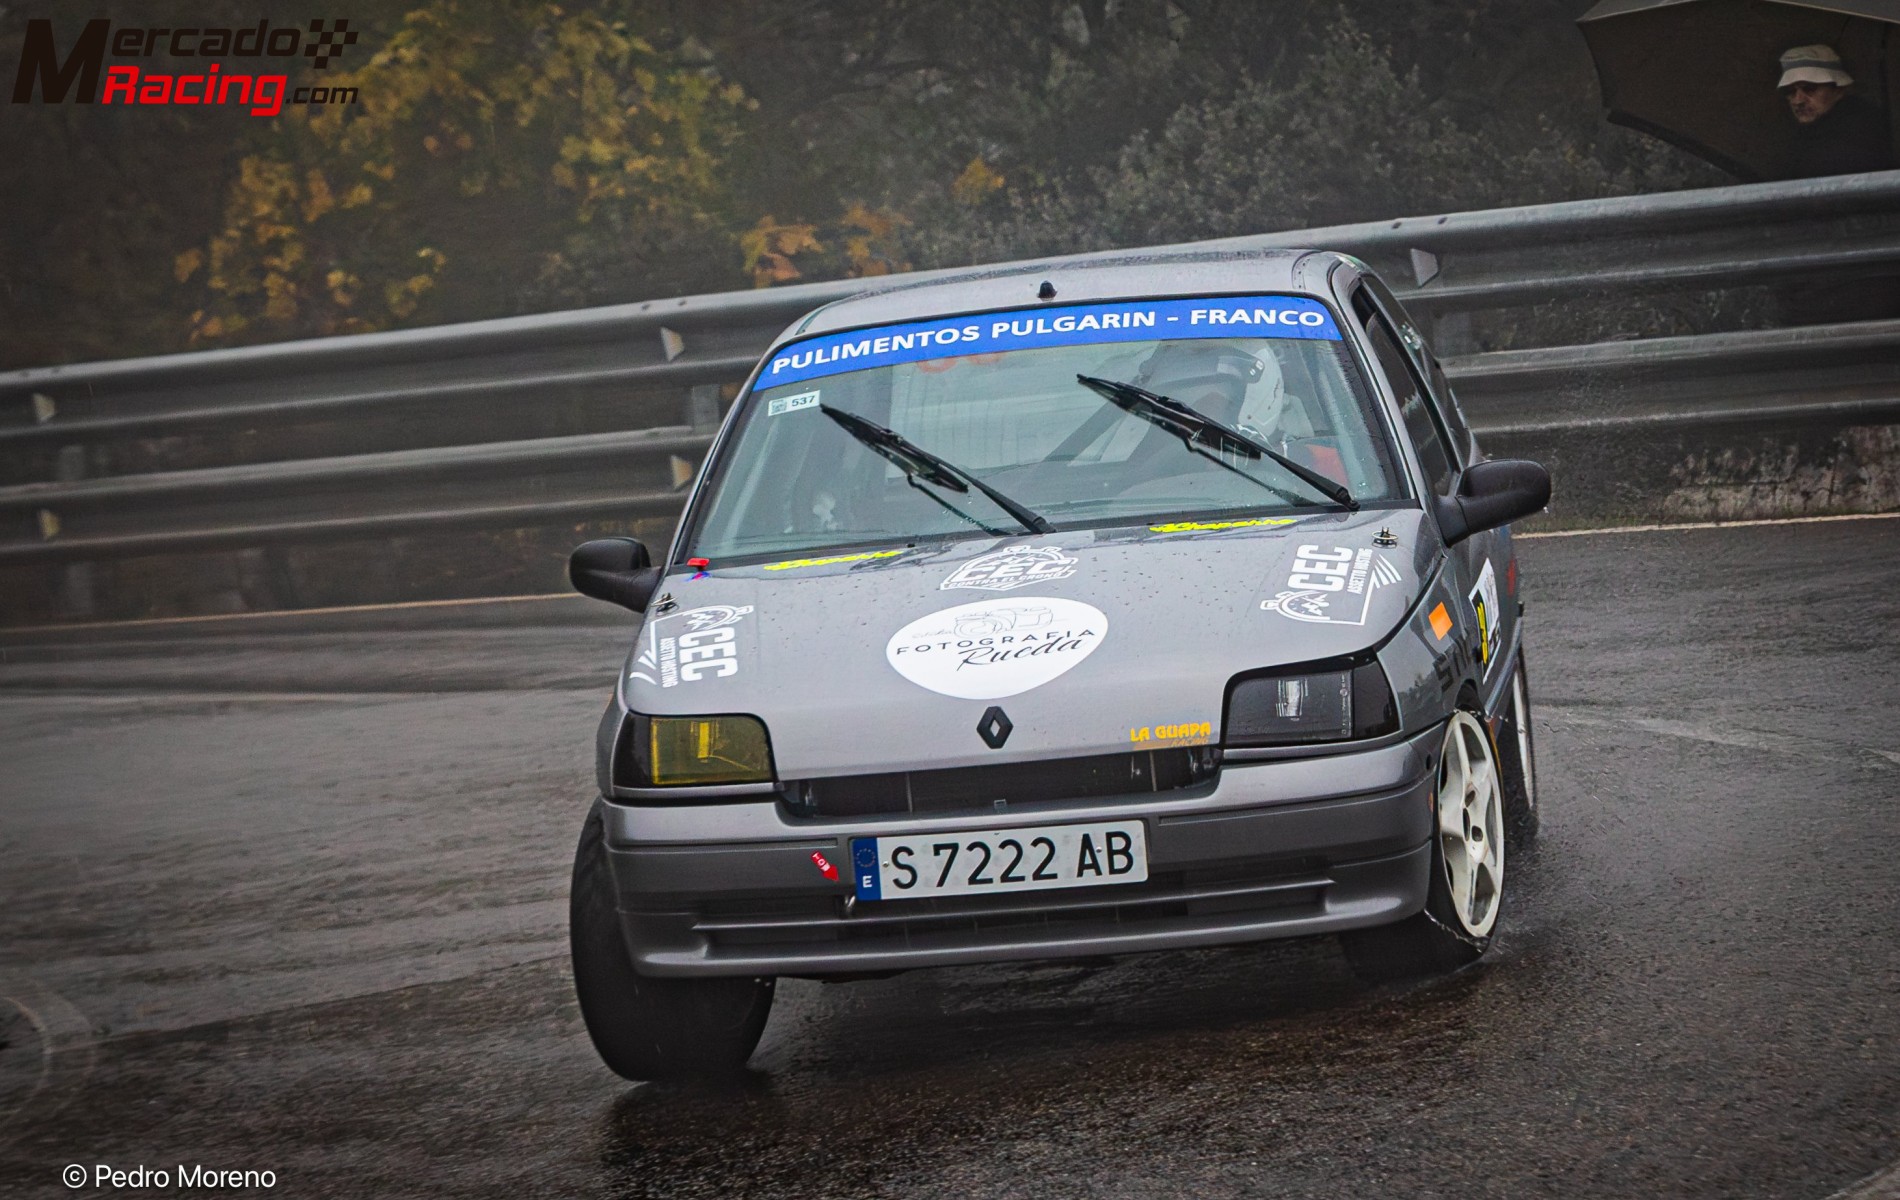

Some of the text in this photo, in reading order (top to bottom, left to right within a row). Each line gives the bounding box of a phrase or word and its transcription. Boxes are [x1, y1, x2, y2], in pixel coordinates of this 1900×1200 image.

[771, 325, 981, 375] PULIMENTOS
[991, 310, 1156, 338] PULGARIN
[1190, 308, 1324, 328] FRANCO
[791, 395, 815, 407] 537
[948, 571, 1066, 588] CONTRA EL CRONO
[950, 561, 1069, 583] CEC
[1287, 544, 1354, 592] CEC
[678, 626, 739, 682] CEC
[896, 628, 1096, 656] FOTOGRAFIA
[956, 636, 1083, 672] Rueda
[1130, 721, 1211, 742] LA GUAPA
[891, 831, 1134, 890] S 7222 AB
[862, 875, 873, 888] E
